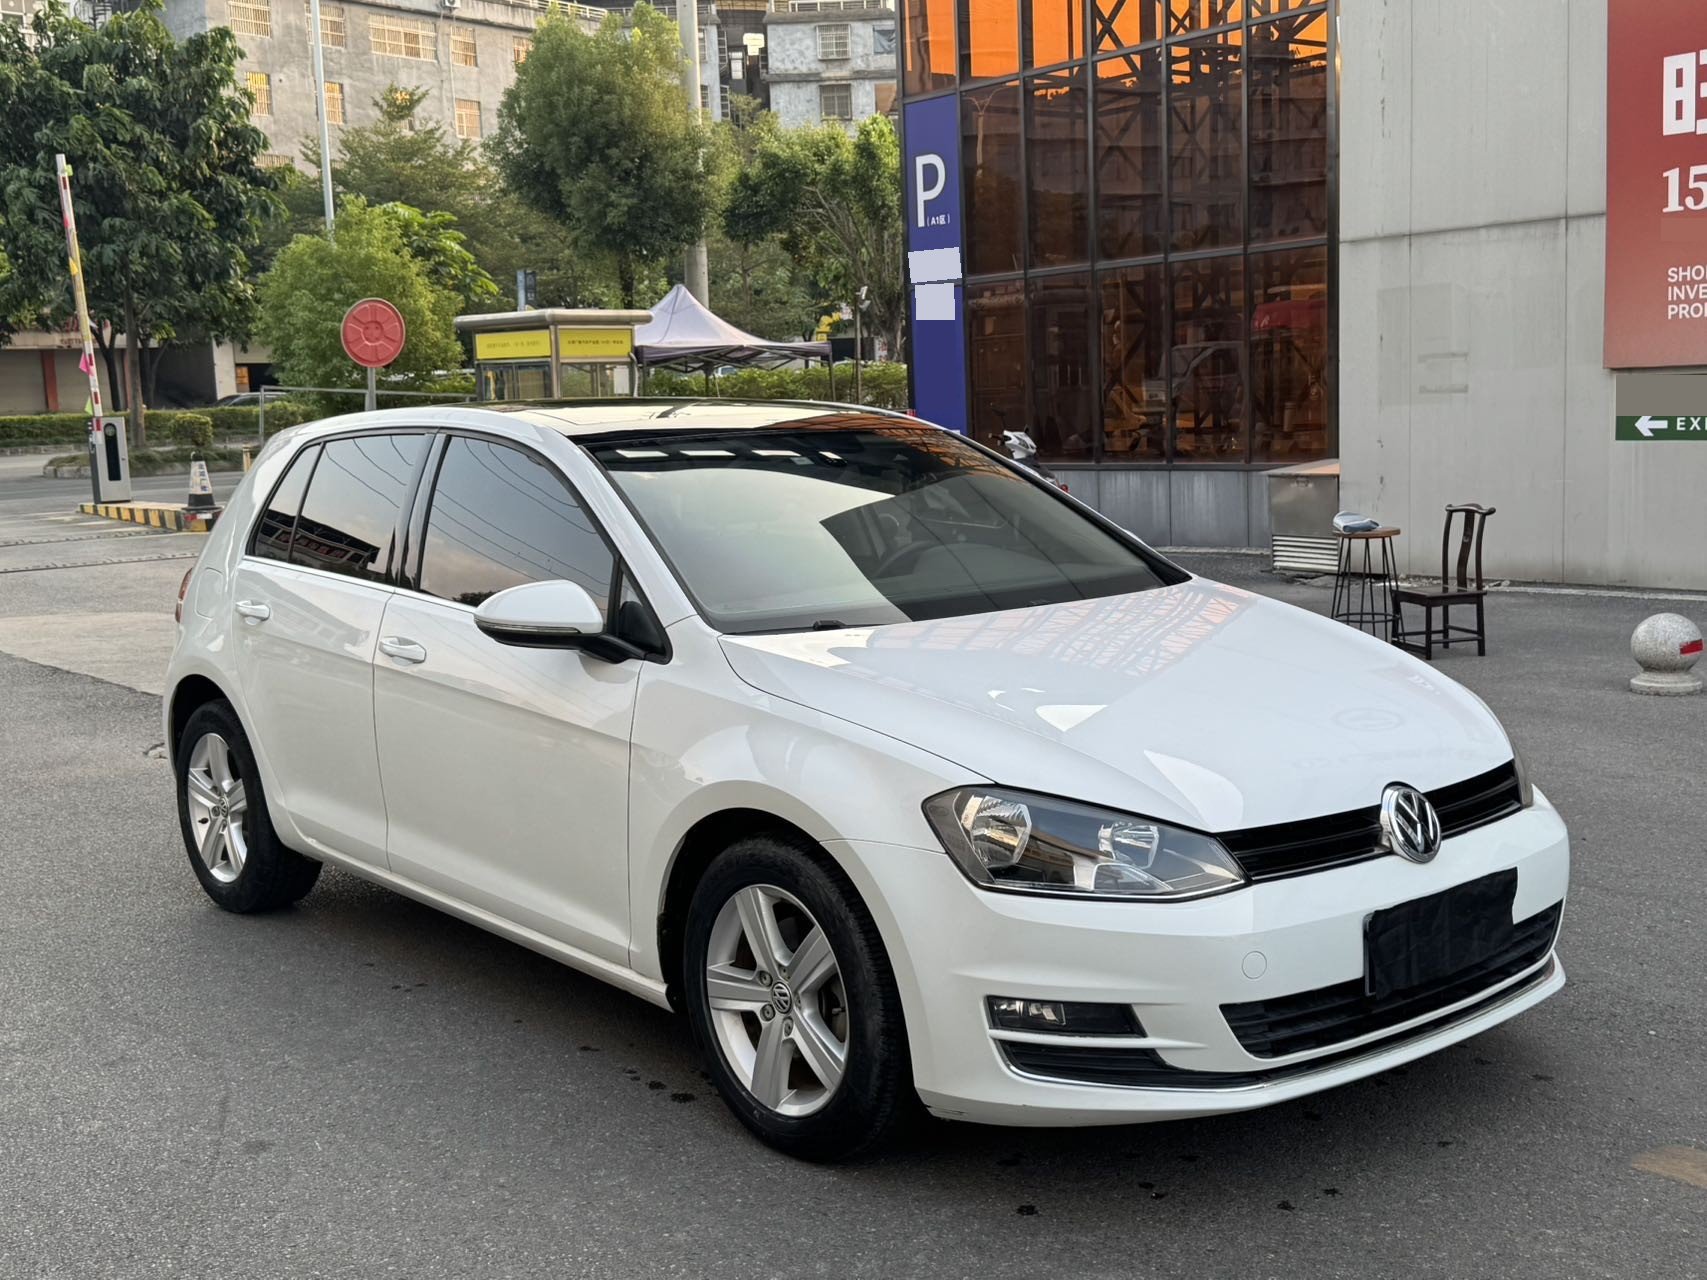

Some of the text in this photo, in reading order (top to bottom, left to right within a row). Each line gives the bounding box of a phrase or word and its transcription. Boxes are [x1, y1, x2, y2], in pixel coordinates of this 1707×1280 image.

[915, 153, 946, 228] P
[1667, 264, 1707, 283] SHO
[1667, 302, 1707, 320] PRO
